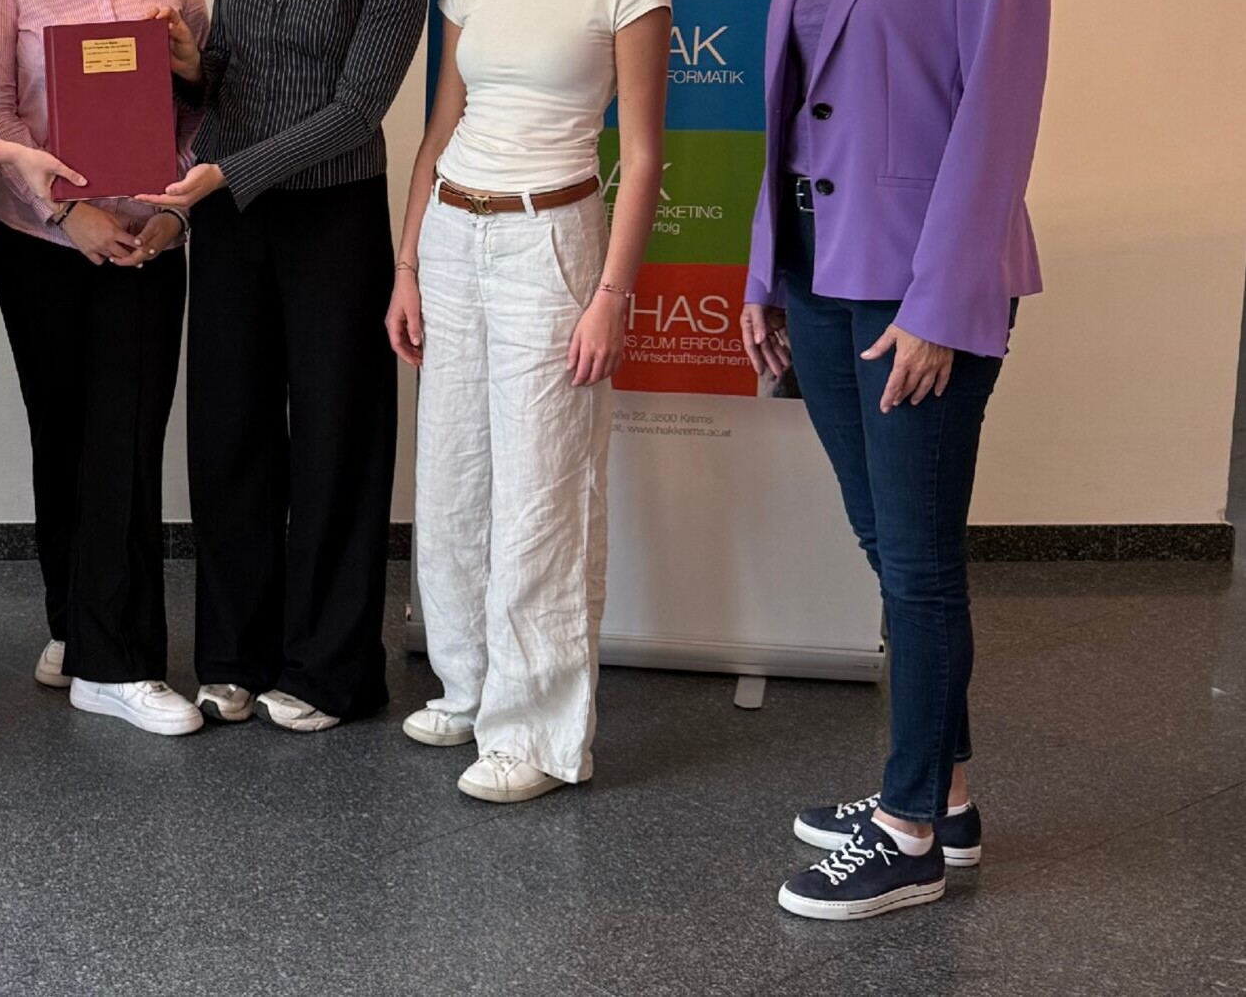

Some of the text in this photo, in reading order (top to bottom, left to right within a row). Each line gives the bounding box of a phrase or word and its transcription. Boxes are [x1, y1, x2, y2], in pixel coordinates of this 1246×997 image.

[628, 293, 730, 334] HAS
[640, 335, 676, 349] ZUM
[680, 336, 742, 351] ERFOLG
